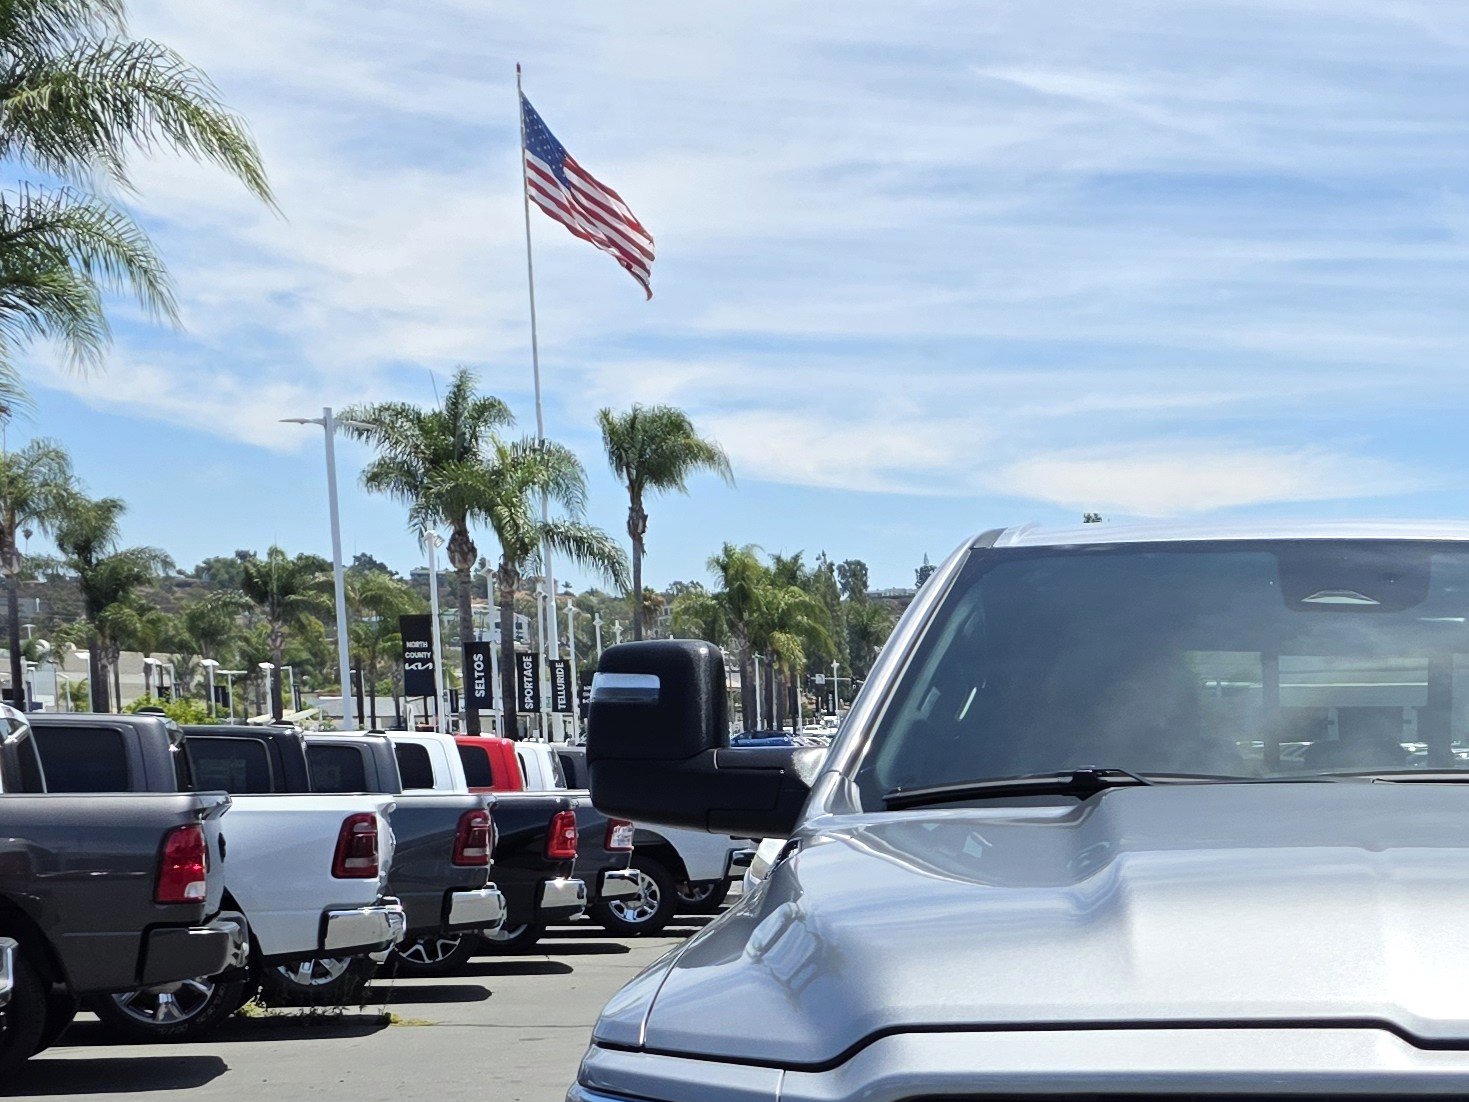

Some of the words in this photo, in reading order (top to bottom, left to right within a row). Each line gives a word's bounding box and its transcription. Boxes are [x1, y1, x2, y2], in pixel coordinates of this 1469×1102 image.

[473, 653, 486, 698] SELTOS
[523, 655, 534, 710] SPORTAGE
[555, 661, 567, 710] TELLURIDE
